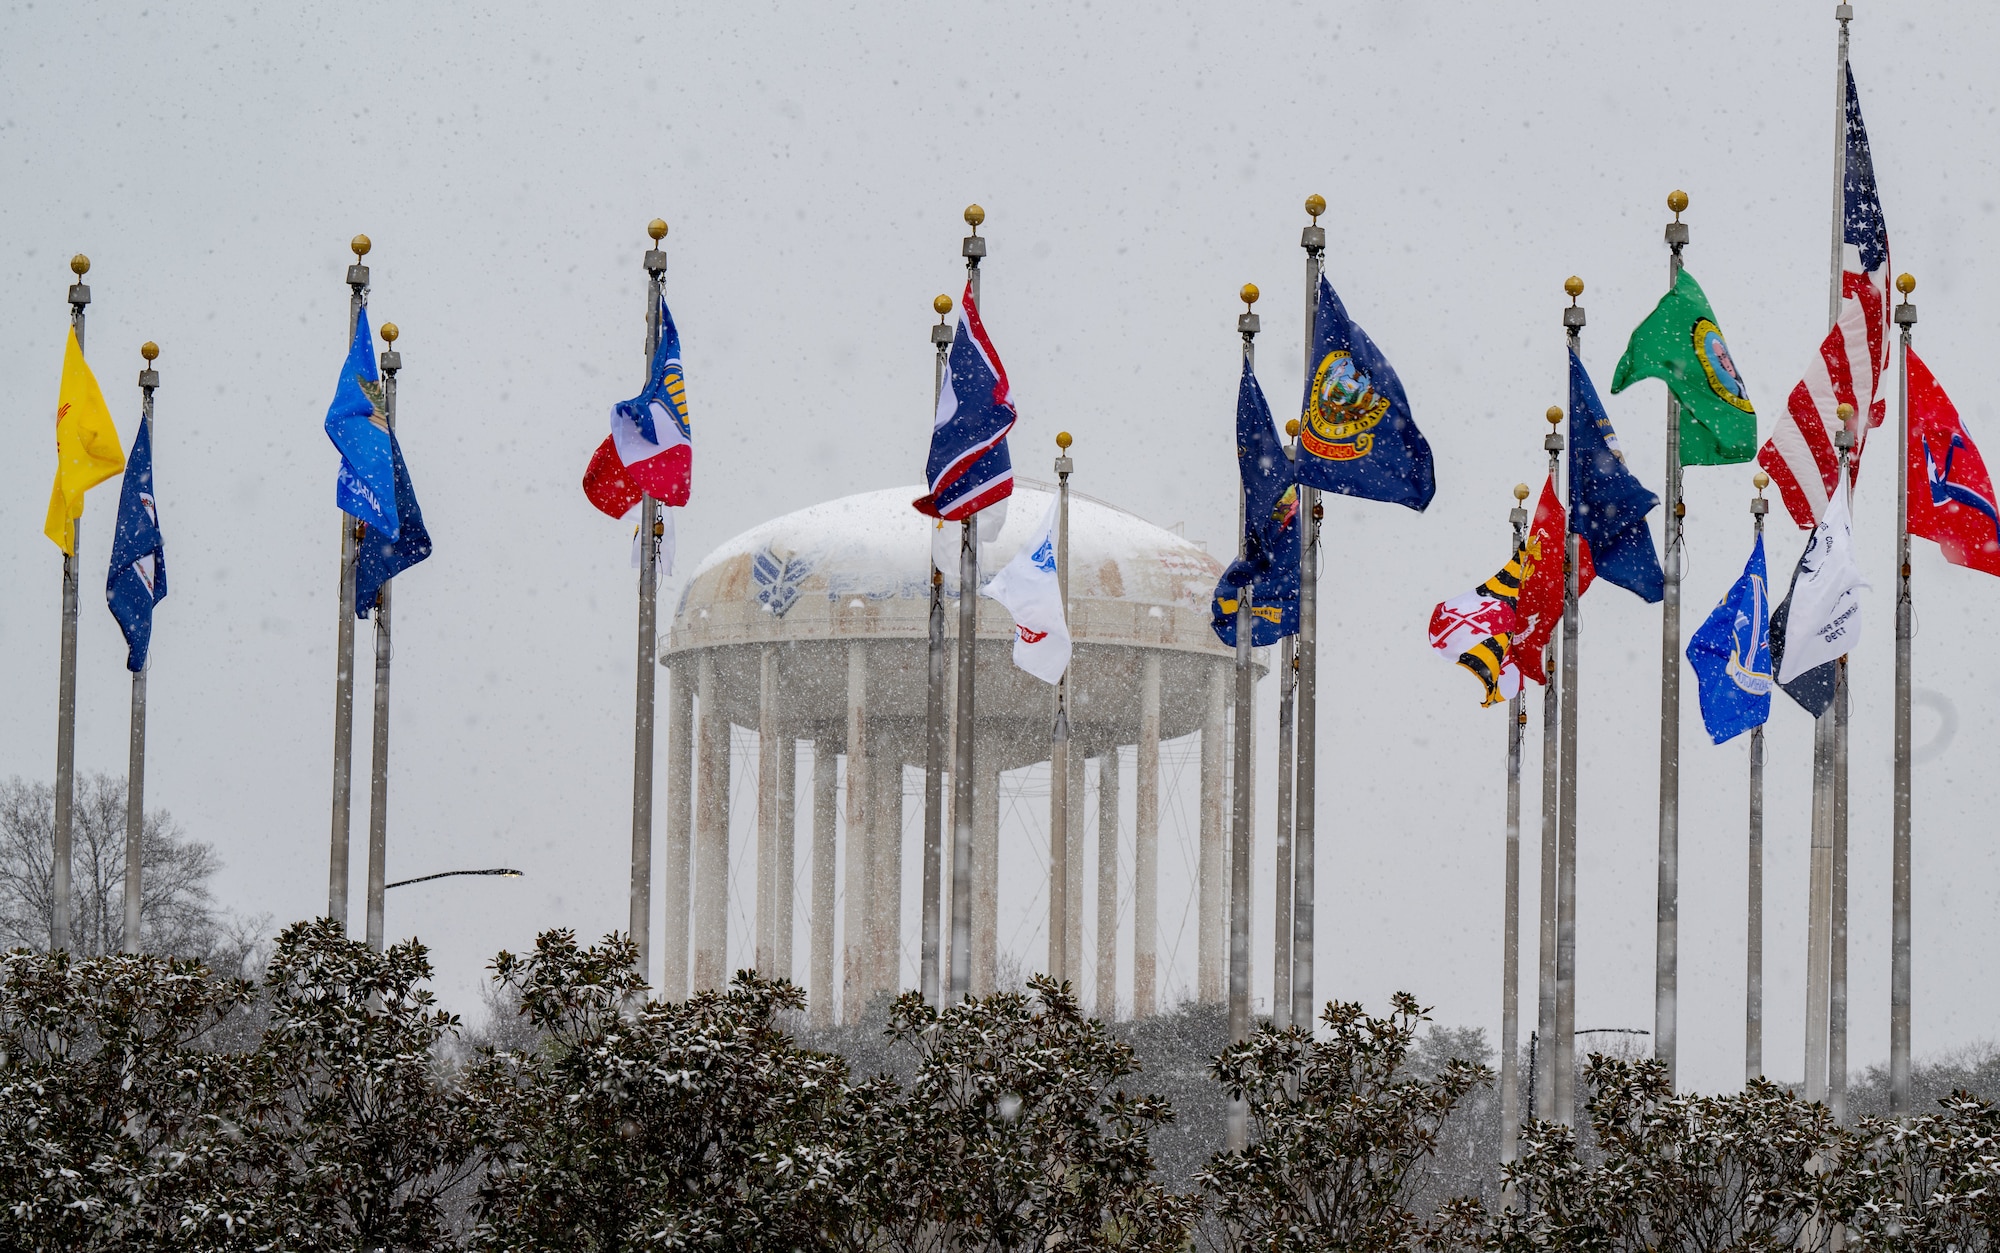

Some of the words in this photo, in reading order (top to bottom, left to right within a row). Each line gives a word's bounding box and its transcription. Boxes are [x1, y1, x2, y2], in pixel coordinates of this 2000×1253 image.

[1334, 425, 1349, 436] OF
[1354, 400, 1390, 430] IDAHO
[1316, 443, 1327, 453] OF
[1328, 445, 1352, 457] IDAHO
